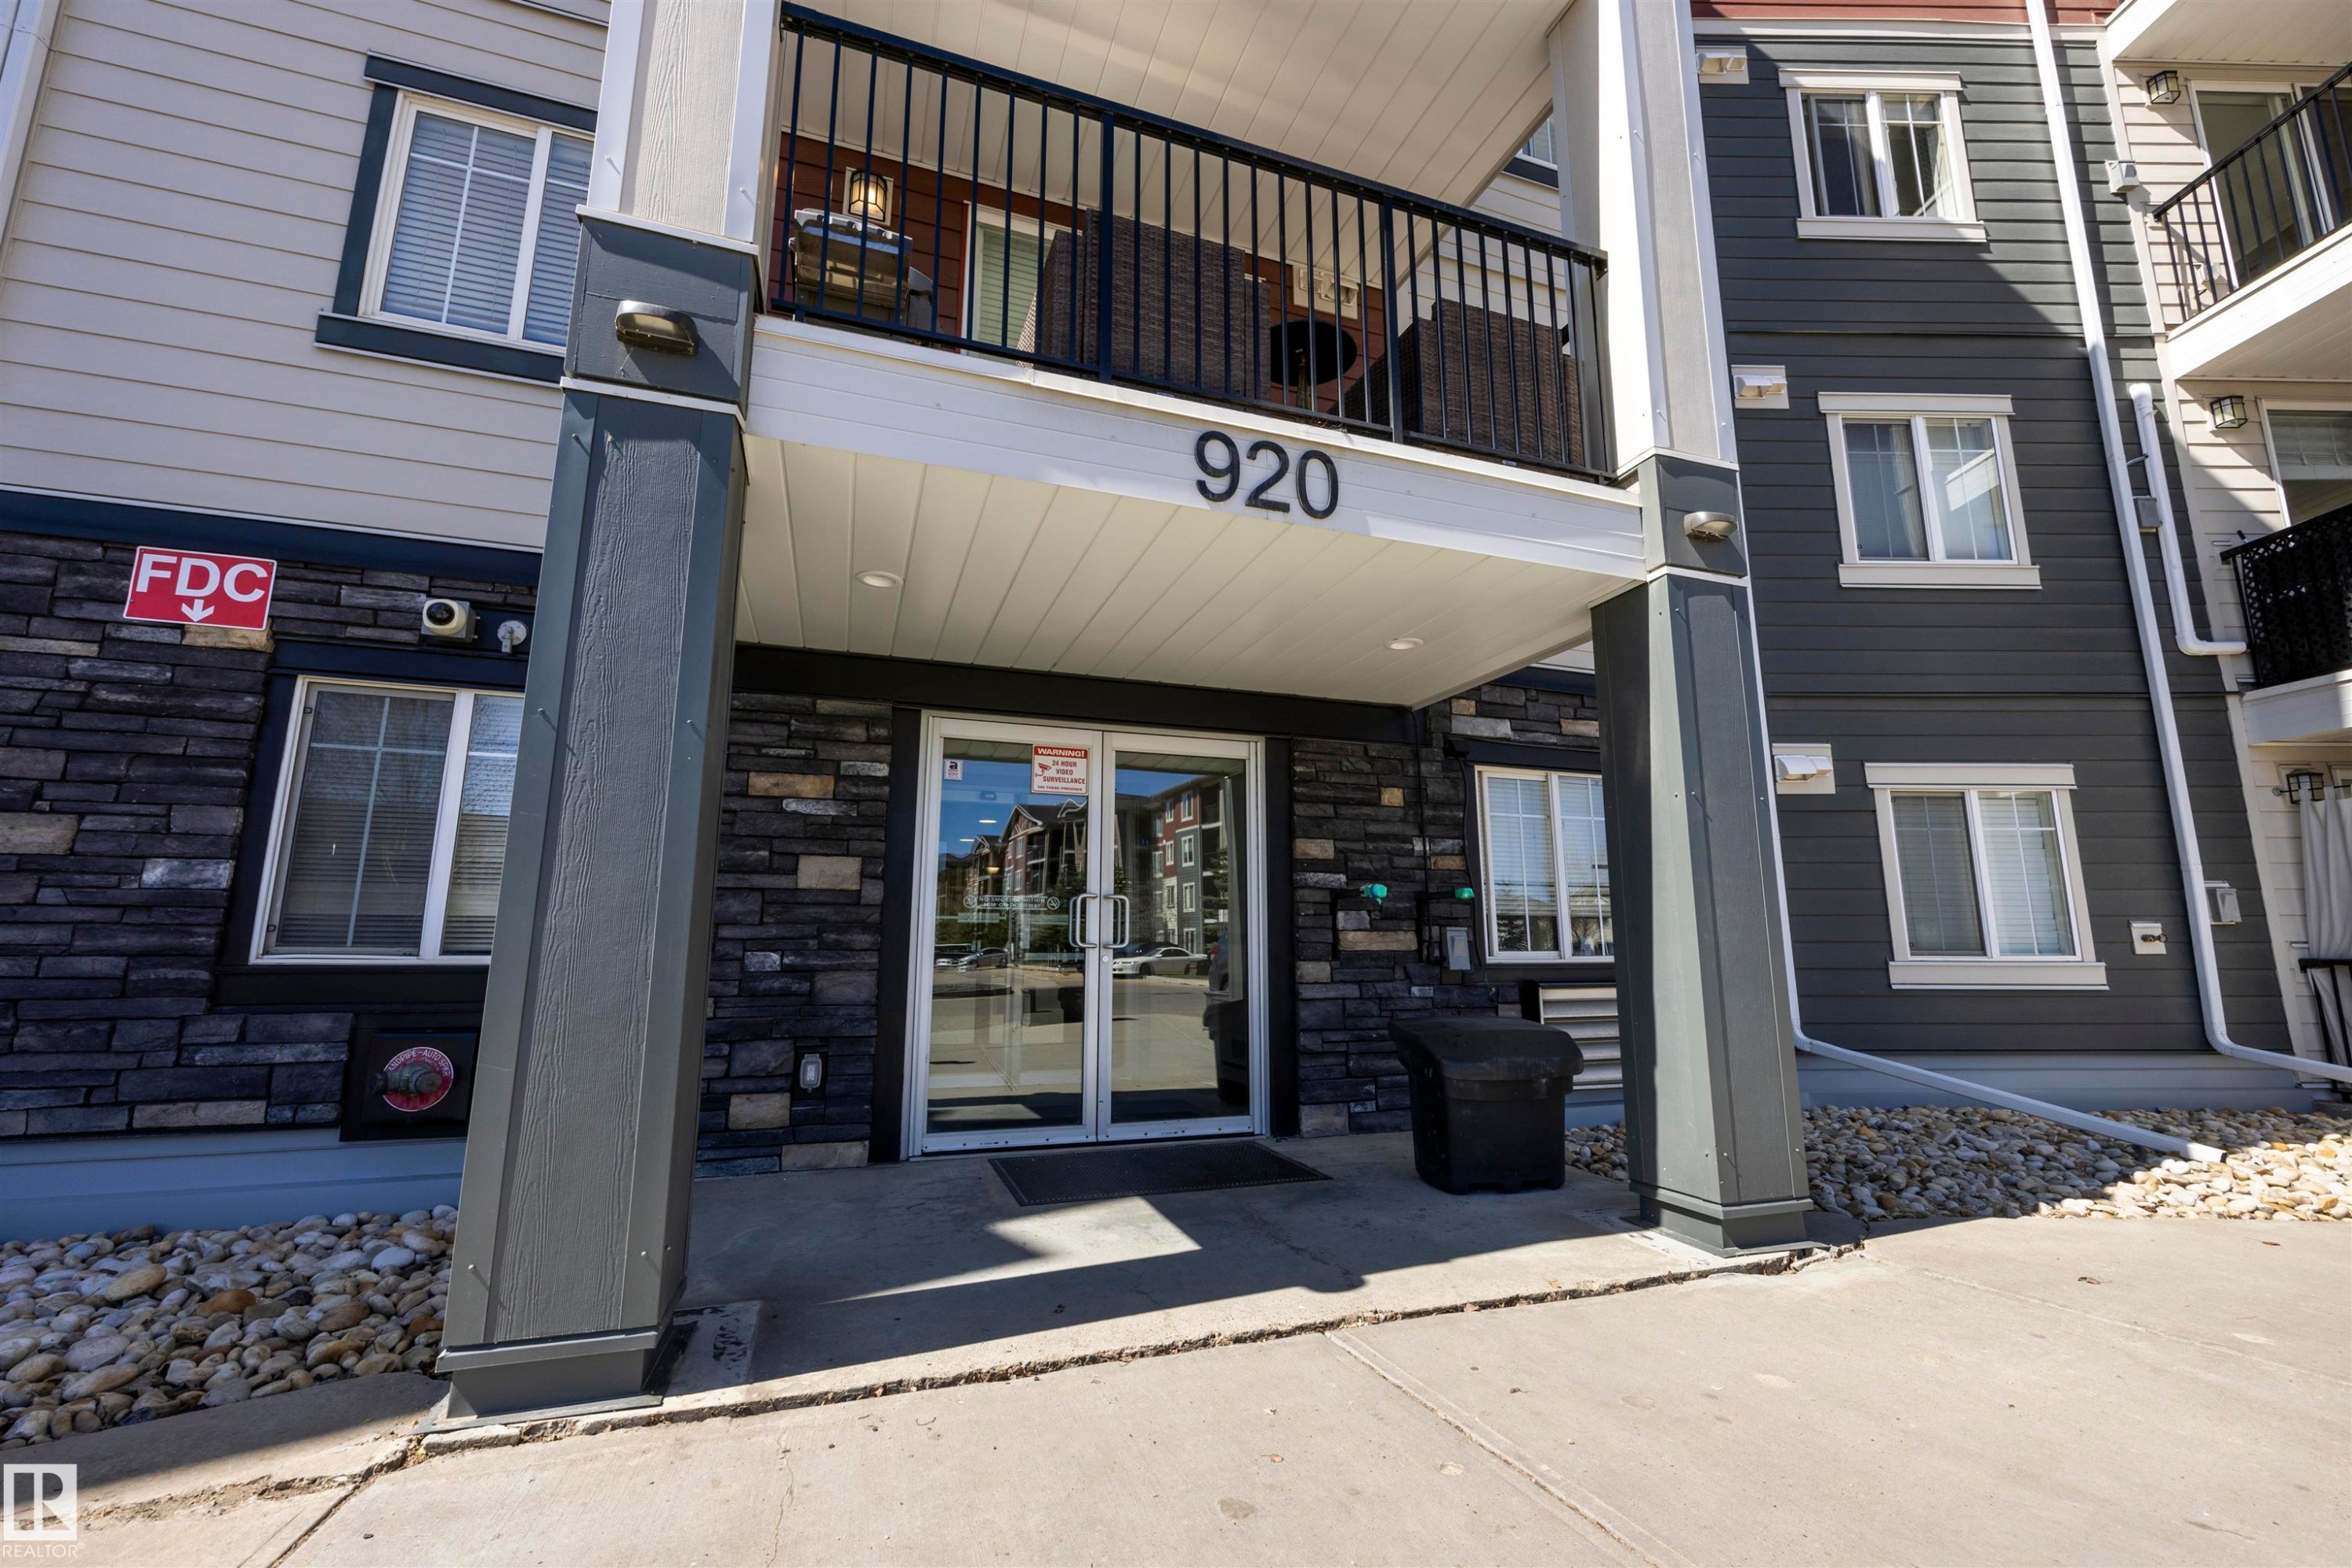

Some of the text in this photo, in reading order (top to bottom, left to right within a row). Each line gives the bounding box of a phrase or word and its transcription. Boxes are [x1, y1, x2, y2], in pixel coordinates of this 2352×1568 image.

[1194, 430, 1339, 519] 920
[136, 554, 268, 603] FDC
[1037, 748, 1085, 757] WARNING!
[1043, 775, 1086, 785] SURVEILLANCE
